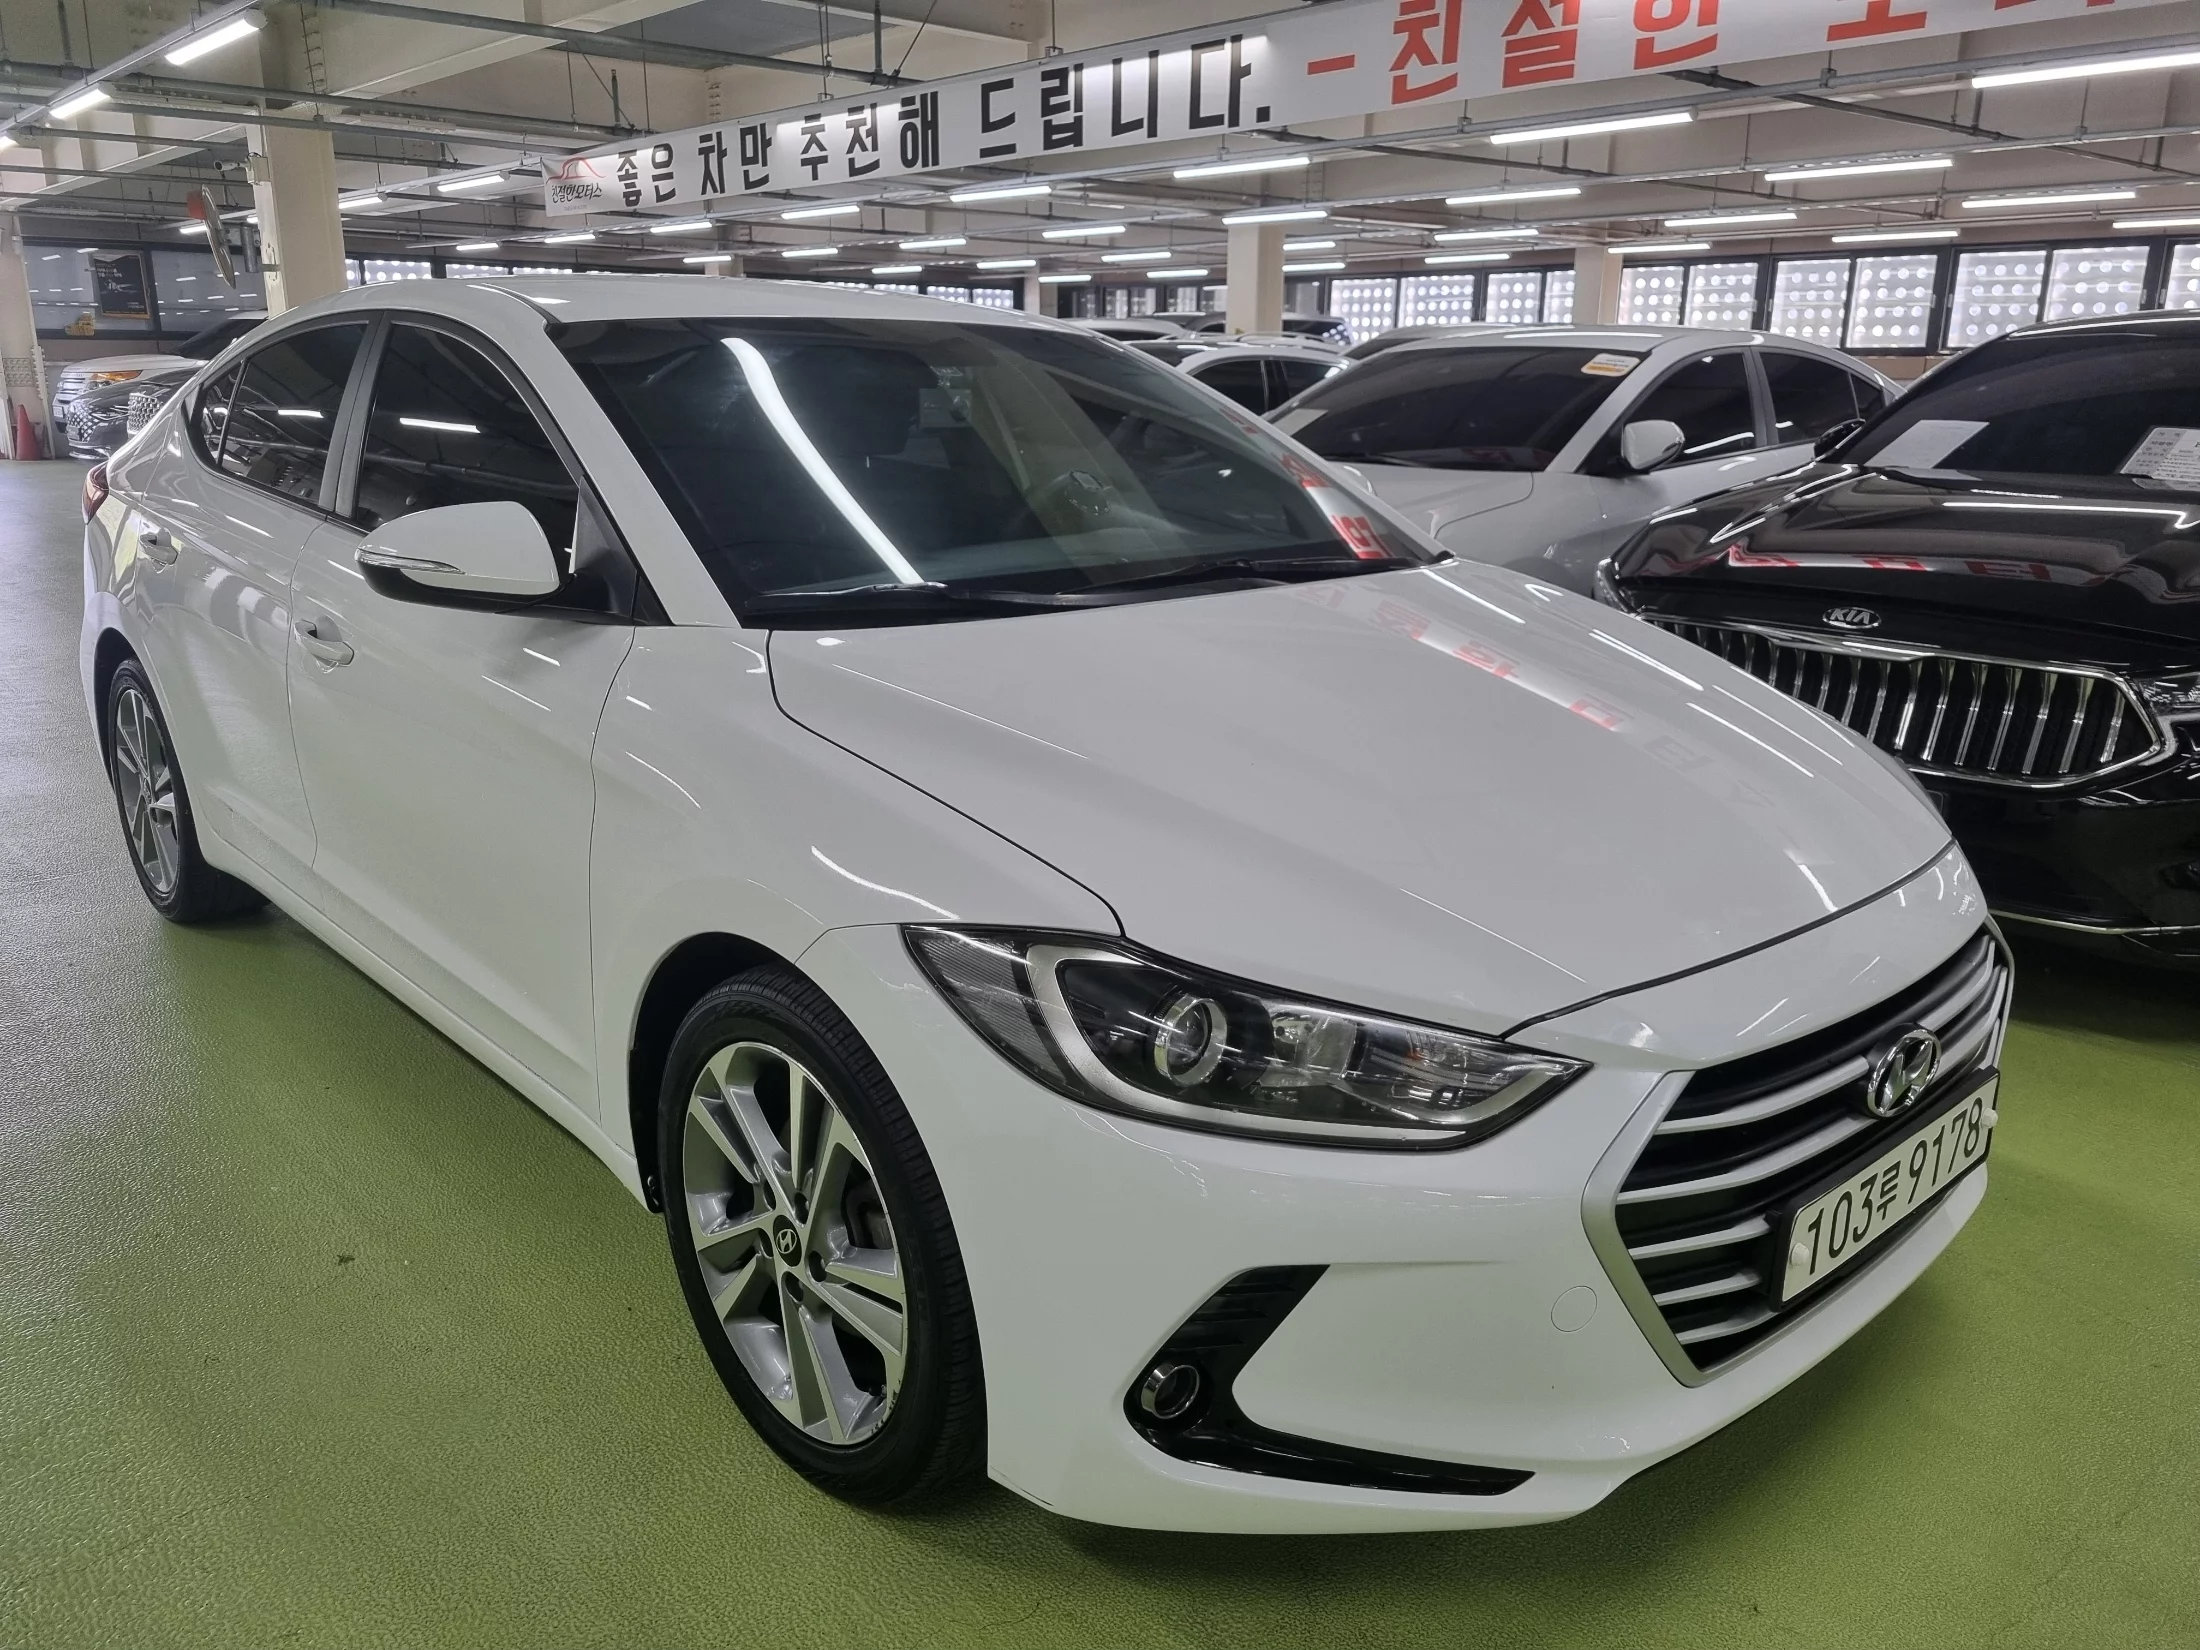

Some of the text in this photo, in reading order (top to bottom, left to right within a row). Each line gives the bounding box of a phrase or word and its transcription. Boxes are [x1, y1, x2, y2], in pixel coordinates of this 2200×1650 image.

[616, 143, 677, 208] 좋은
[698, 122, 773, 196] 차만
[800, 91, 940, 182] 추천해
[979, 34, 1271, 159] 드립니다.
[1829, 608, 1871, 625] KIA
